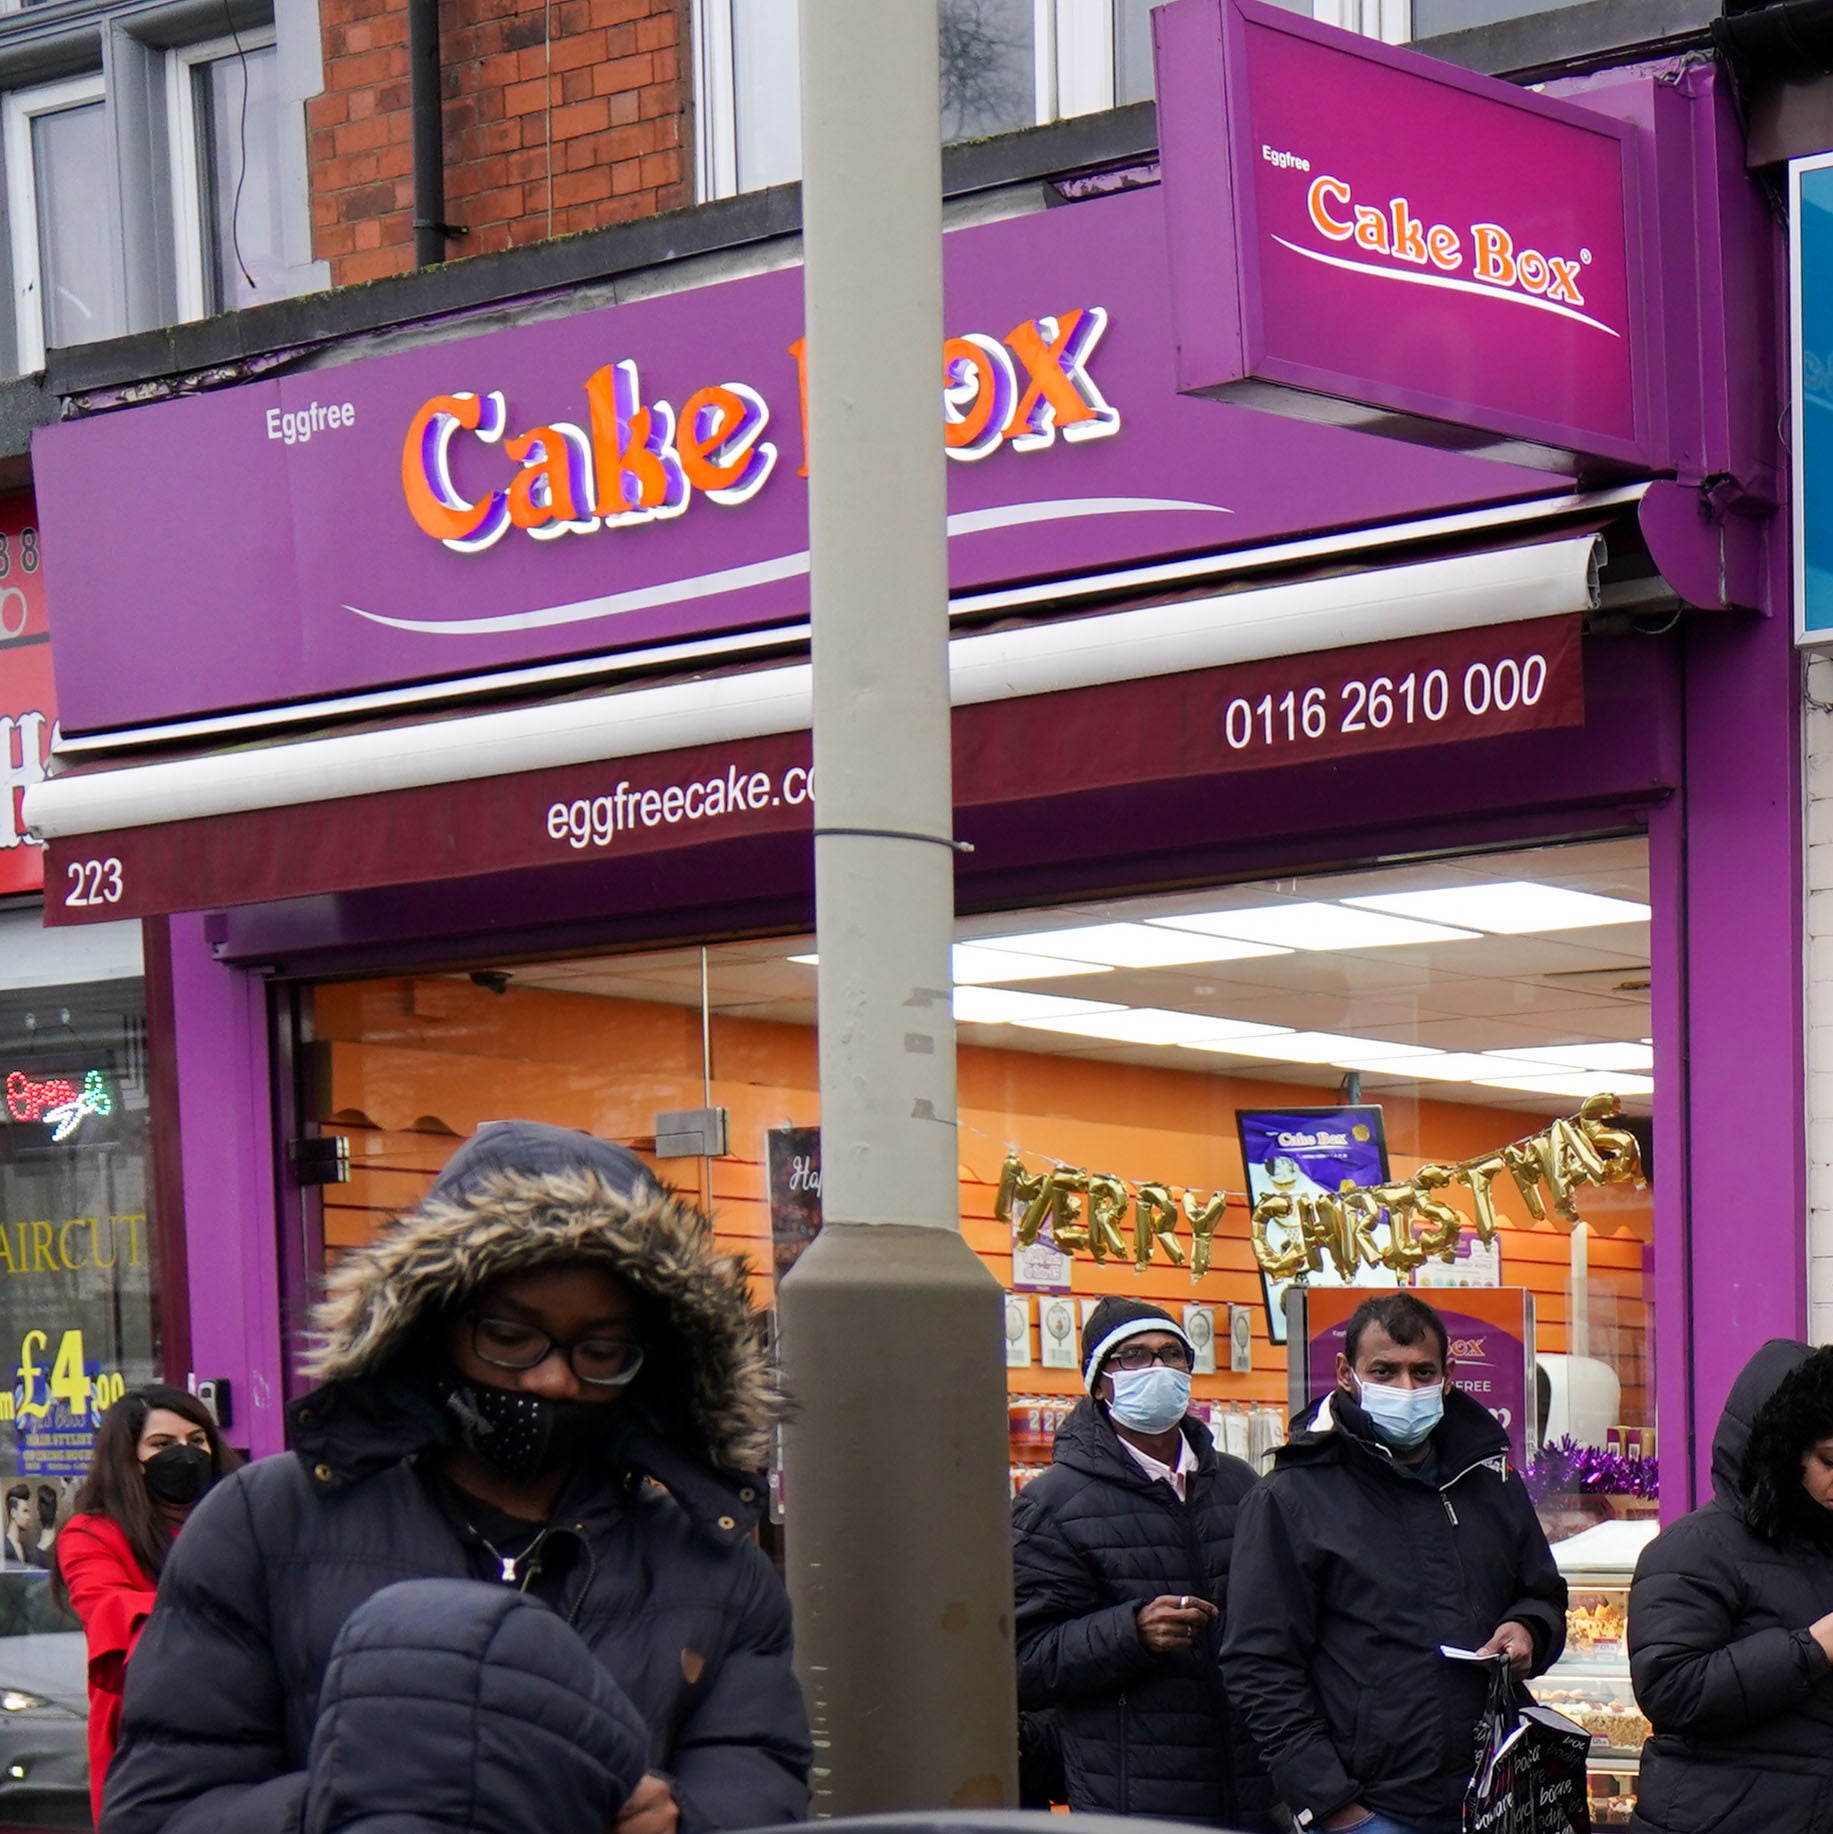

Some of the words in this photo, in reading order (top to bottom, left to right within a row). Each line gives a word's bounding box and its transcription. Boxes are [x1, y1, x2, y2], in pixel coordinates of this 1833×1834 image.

[1262, 144, 1311, 172] Eggfree
[1307, 175, 1463, 270] Cake
[266, 401, 356, 444] Eggfree
[402, 359, 778, 552] Cake
[787, 306, 1121, 480] ox
[1226, 686, 1327, 749] 0116
[1341, 676, 1449, 732] 2610
[1464, 653, 1548, 715] 000
[65, 857, 124, 907] 223
[6, 1071, 78, 1122] Open
[995, 1153, 1227, 1284] MERRY
[1251, 1091, 1648, 1287] CHRISTMAS
